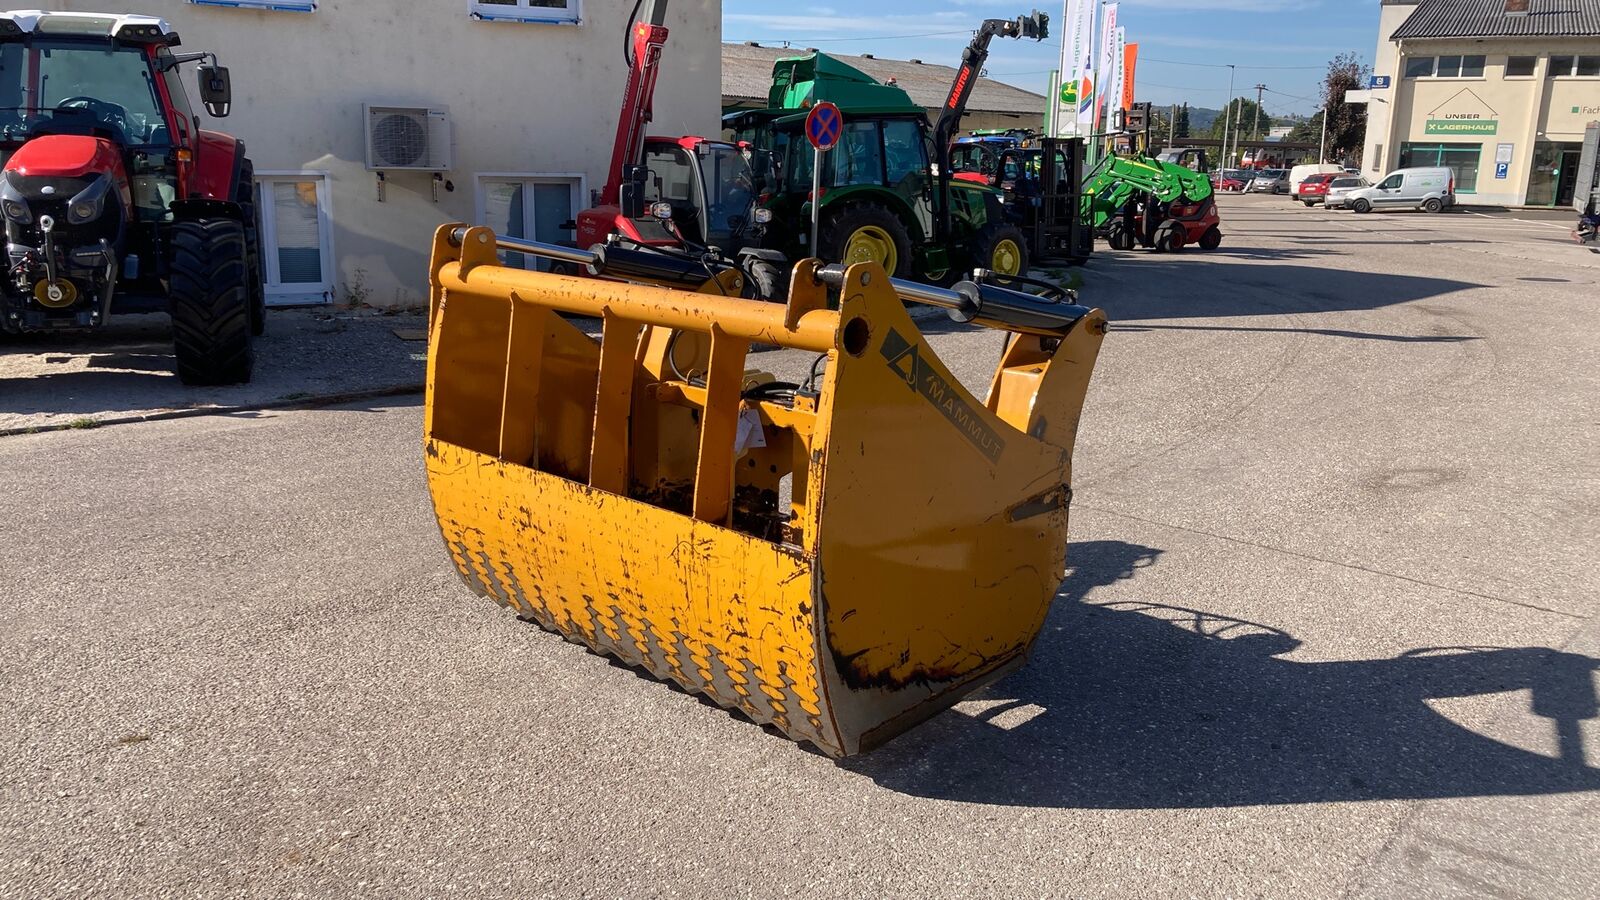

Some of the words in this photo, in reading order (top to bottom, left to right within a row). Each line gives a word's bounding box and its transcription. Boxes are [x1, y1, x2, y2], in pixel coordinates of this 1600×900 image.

[948, 65, 970, 109] MANITOU
[1498, 163, 1507, 173] P
[928, 380, 1001, 455] MAMMUT
